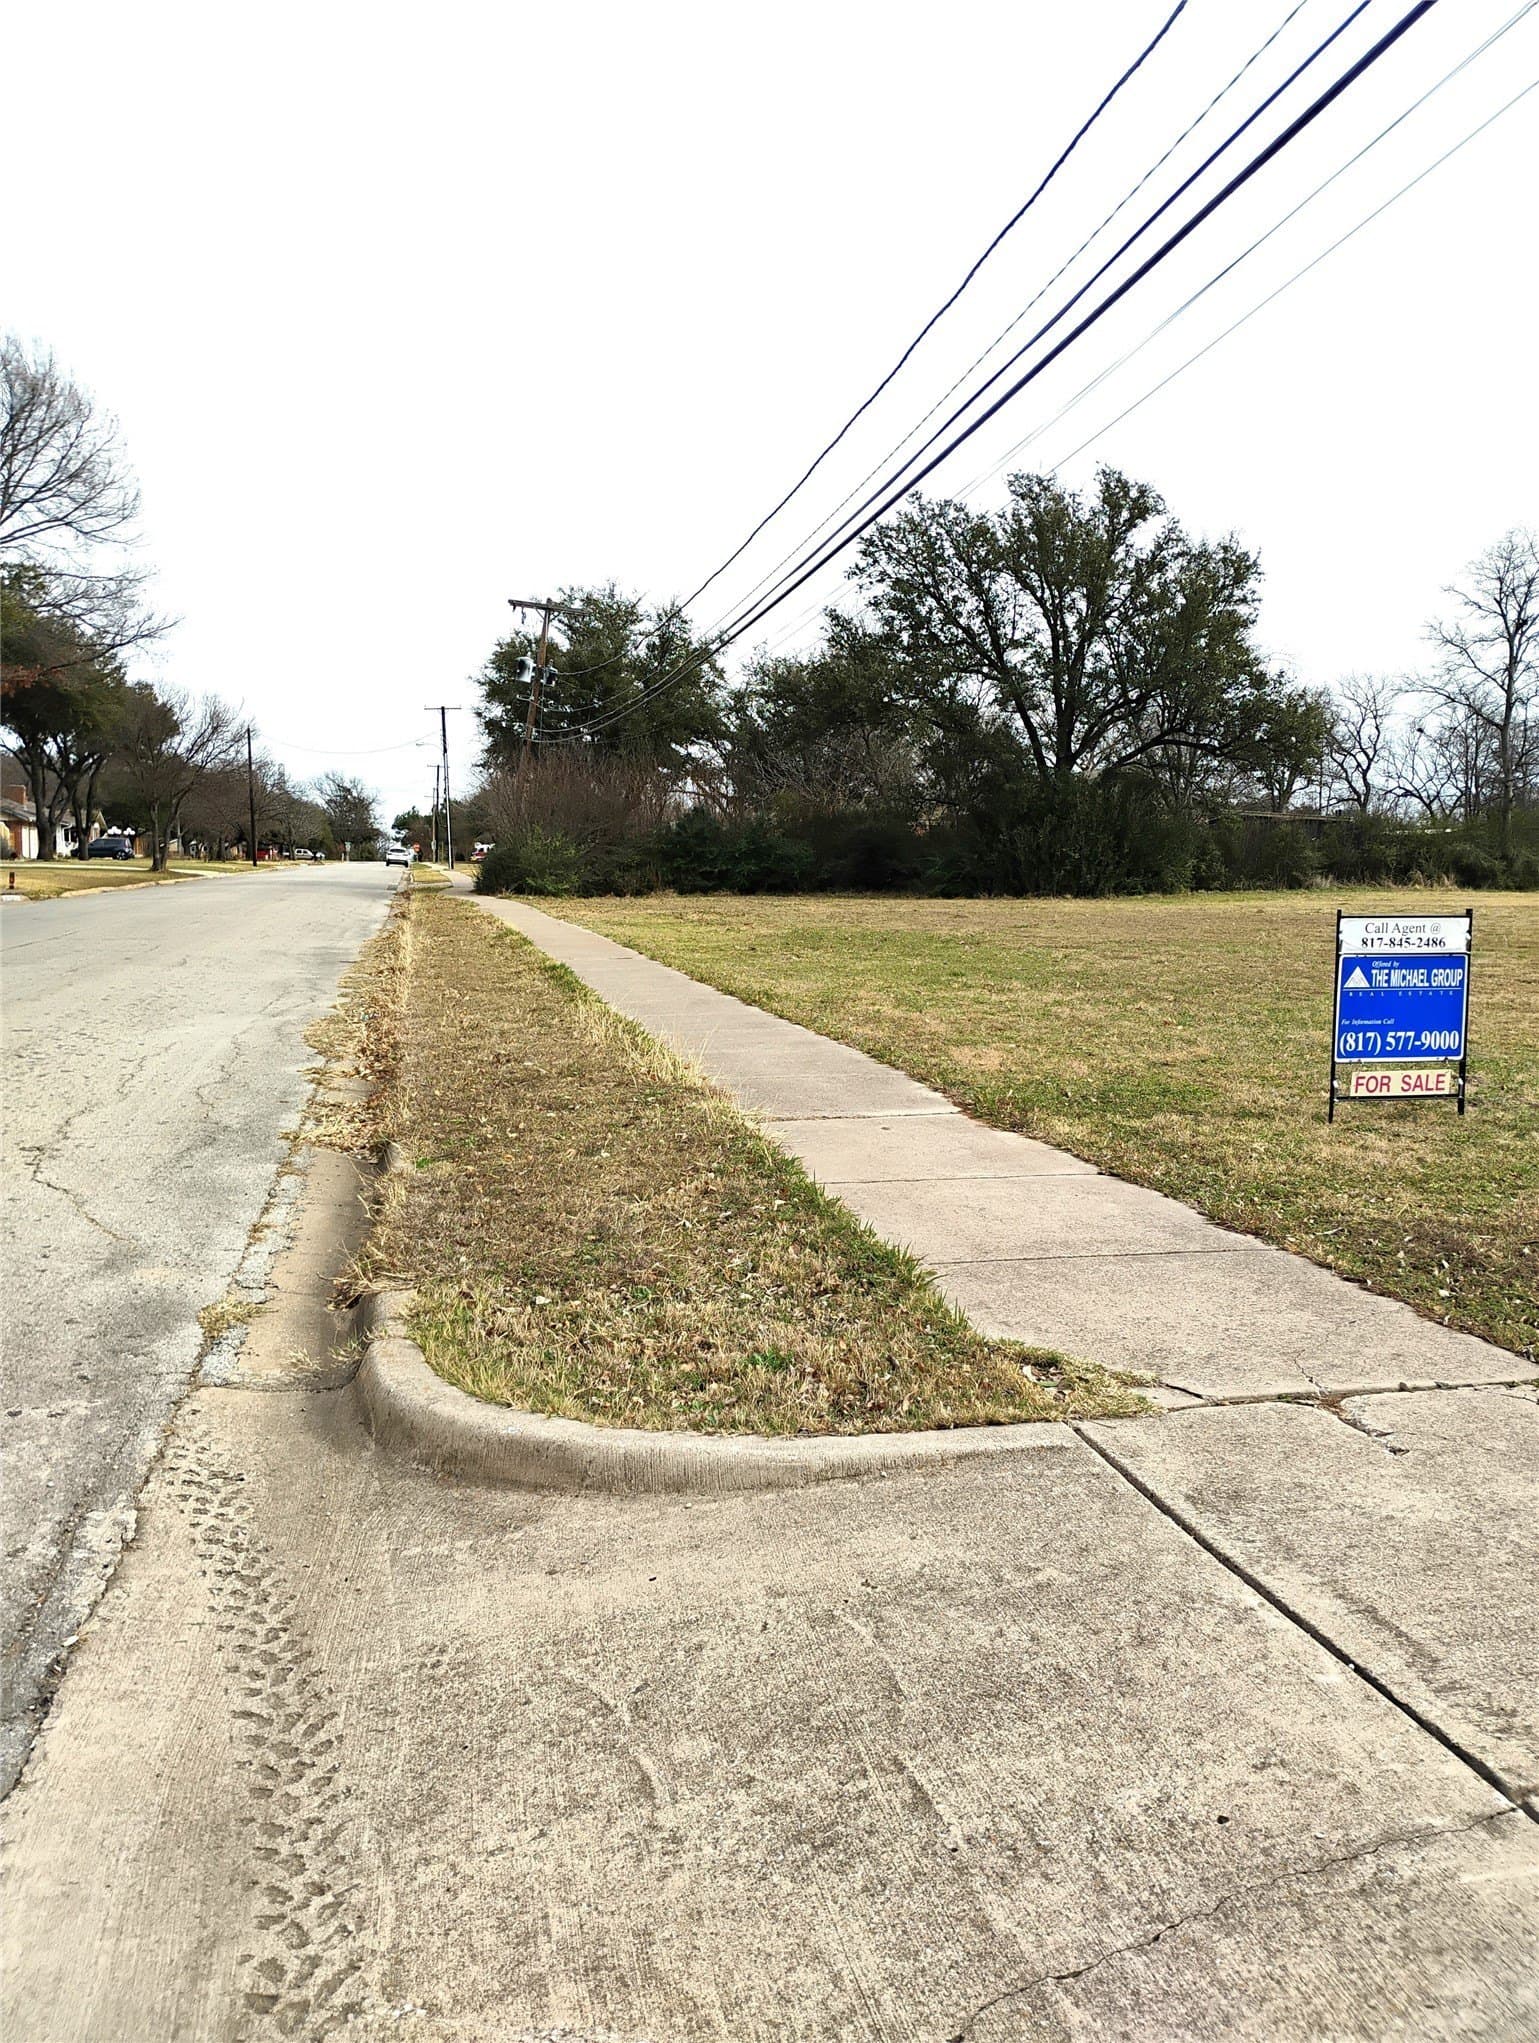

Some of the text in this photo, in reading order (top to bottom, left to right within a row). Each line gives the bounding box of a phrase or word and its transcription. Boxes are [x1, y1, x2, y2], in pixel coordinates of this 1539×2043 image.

[1365, 923, 1440, 936] Call Agent @
[1362, 937, 1446, 948] 817-845-2486
[1372, 968, 1463, 987] THE MICHAEL GROUP
[1339, 1030, 1460, 1055] (817) 577-9000
[1354, 1074, 1446, 1093] FOR SALE
